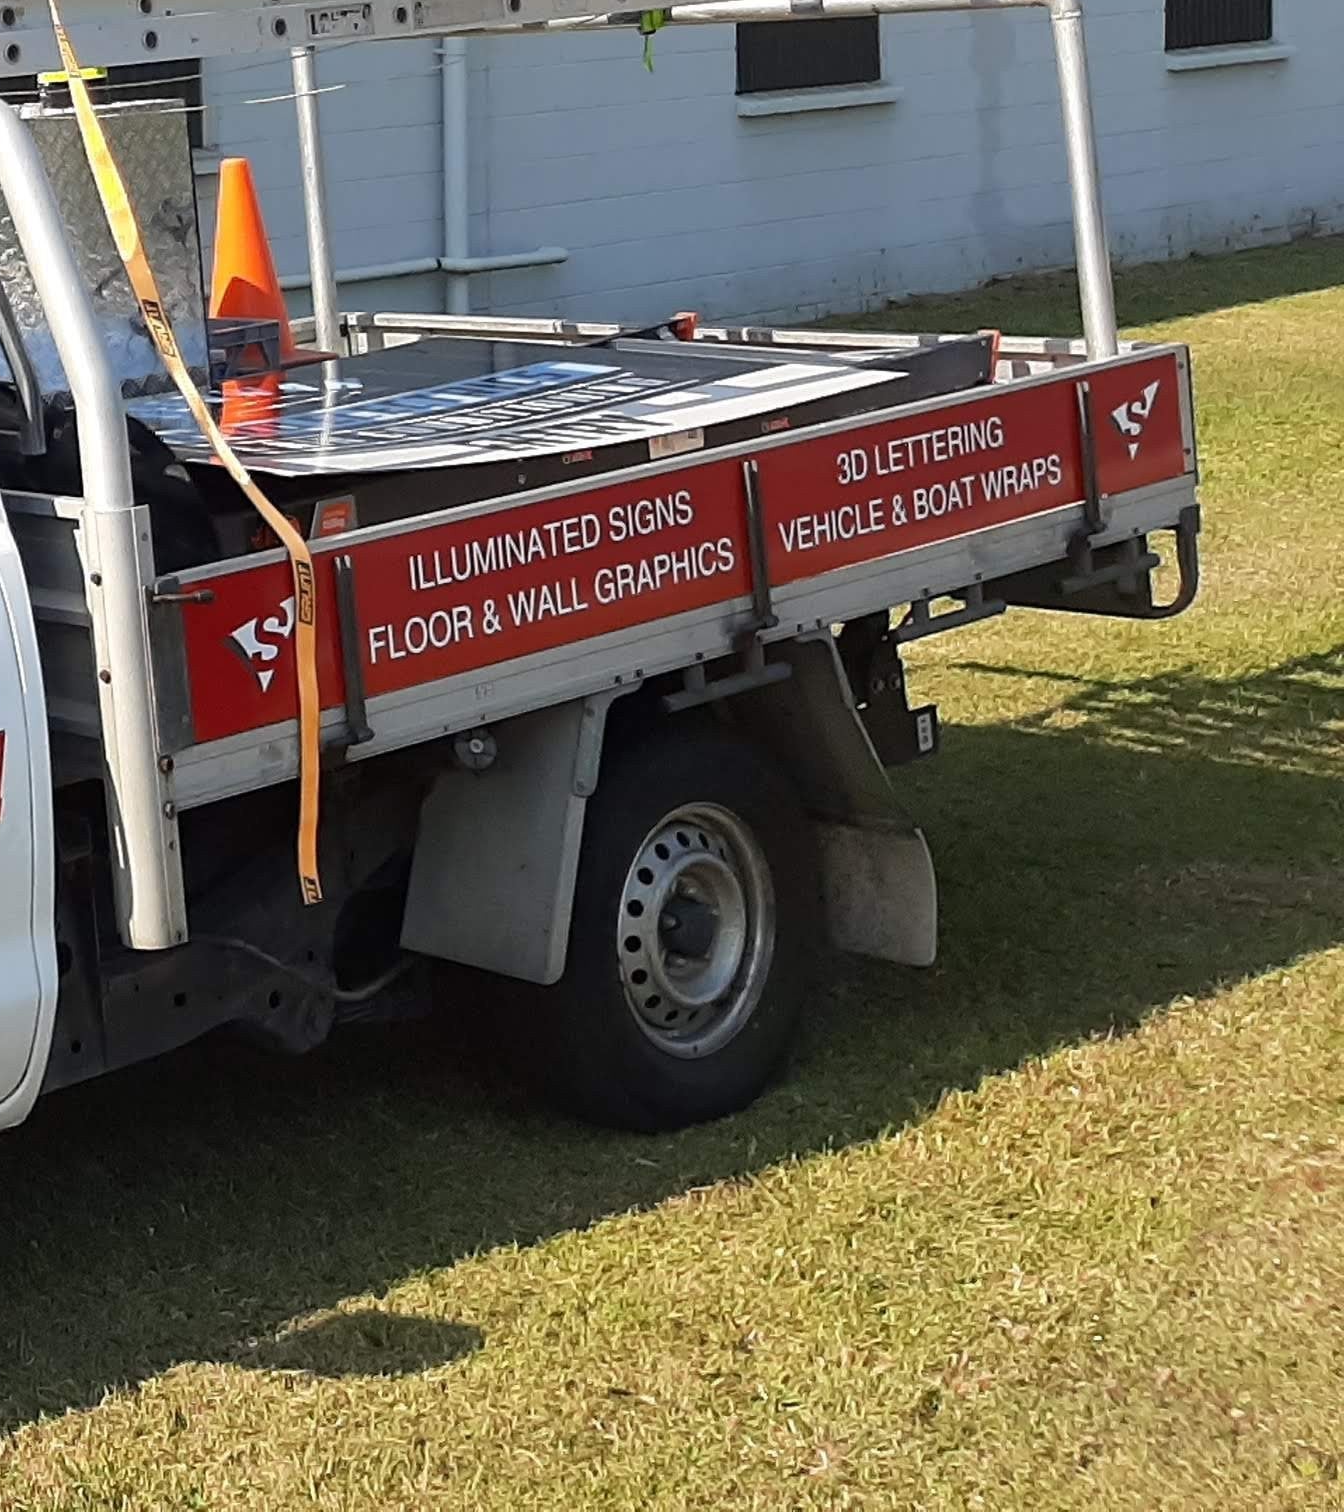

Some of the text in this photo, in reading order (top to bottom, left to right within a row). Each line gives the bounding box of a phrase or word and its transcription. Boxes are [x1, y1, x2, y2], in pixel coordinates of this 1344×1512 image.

[835, 417, 1005, 486] 3D LETTERING
[407, 509, 601, 591] ILLUMINATED
[608, 490, 695, 547] SIGNS
[777, 453, 1063, 554] VEHICLE & BOAT WRAPS
[368, 537, 737, 664] FLOOR & WALL GRAPHICS
